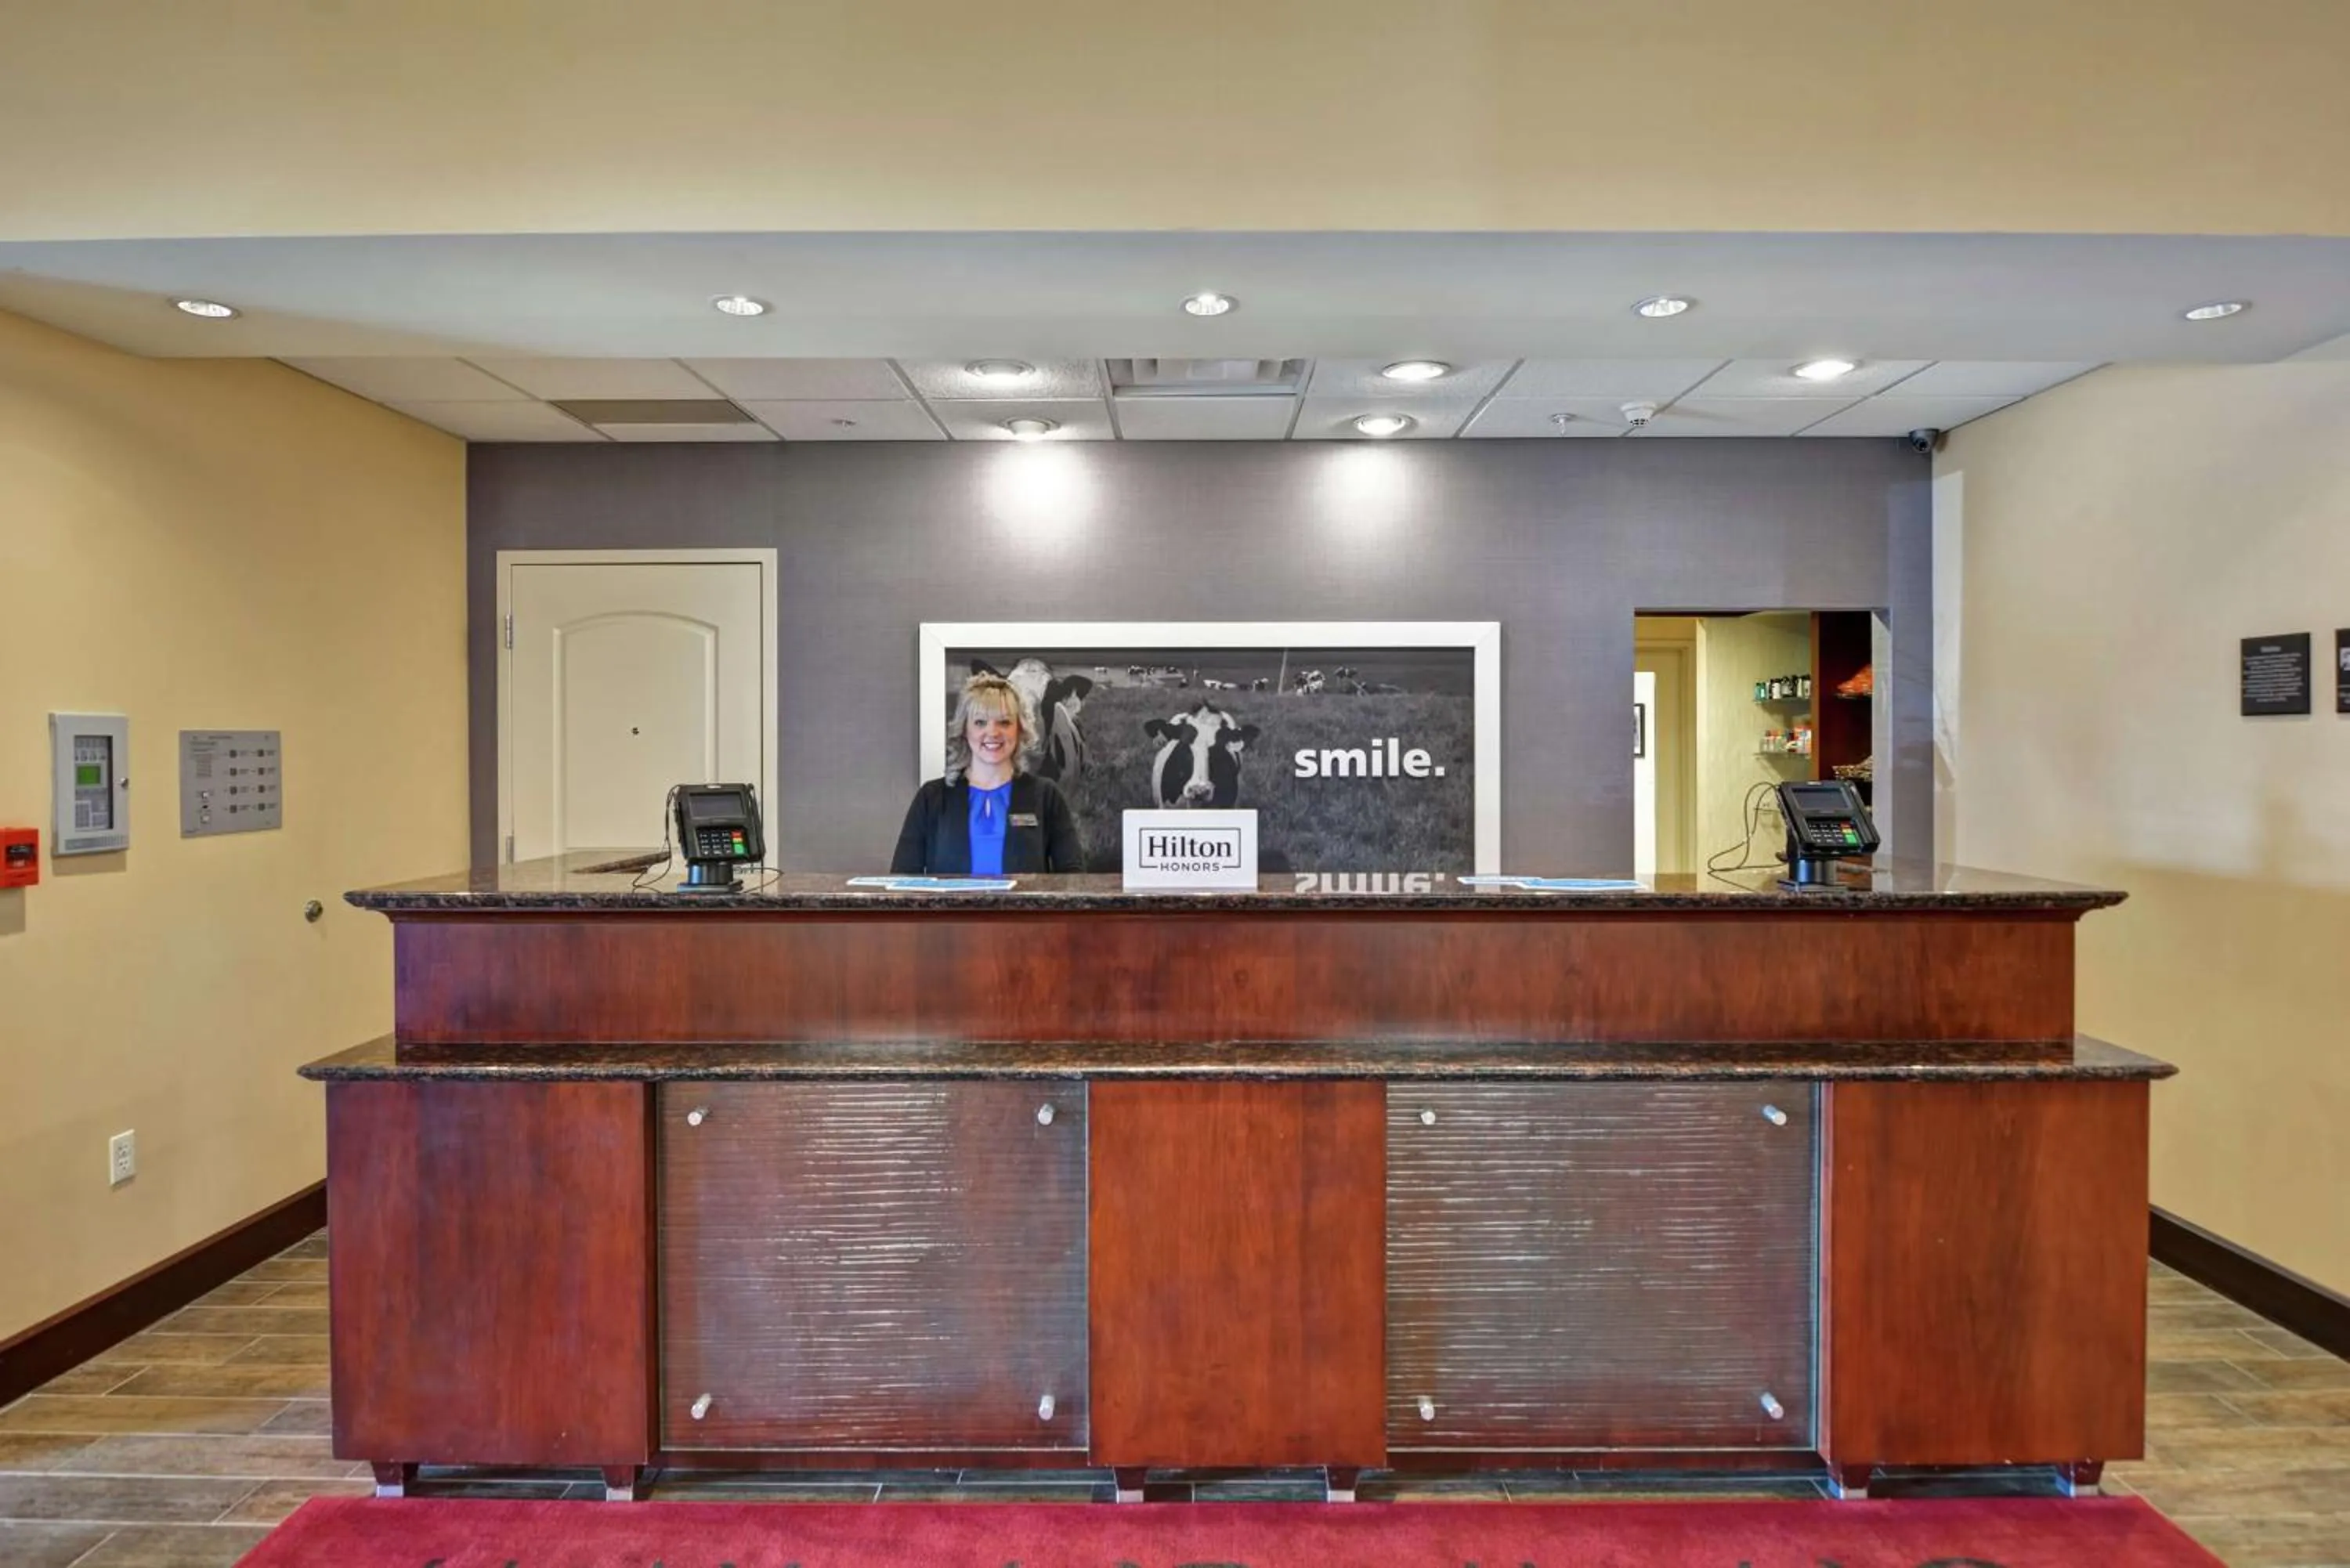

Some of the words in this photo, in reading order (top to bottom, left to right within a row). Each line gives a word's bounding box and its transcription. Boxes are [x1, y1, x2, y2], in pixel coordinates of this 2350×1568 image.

[1295, 738, 1445, 778] smile.
[1148, 836, 1232, 858] Hilton
[1159, 862, 1220, 873] HONORS
